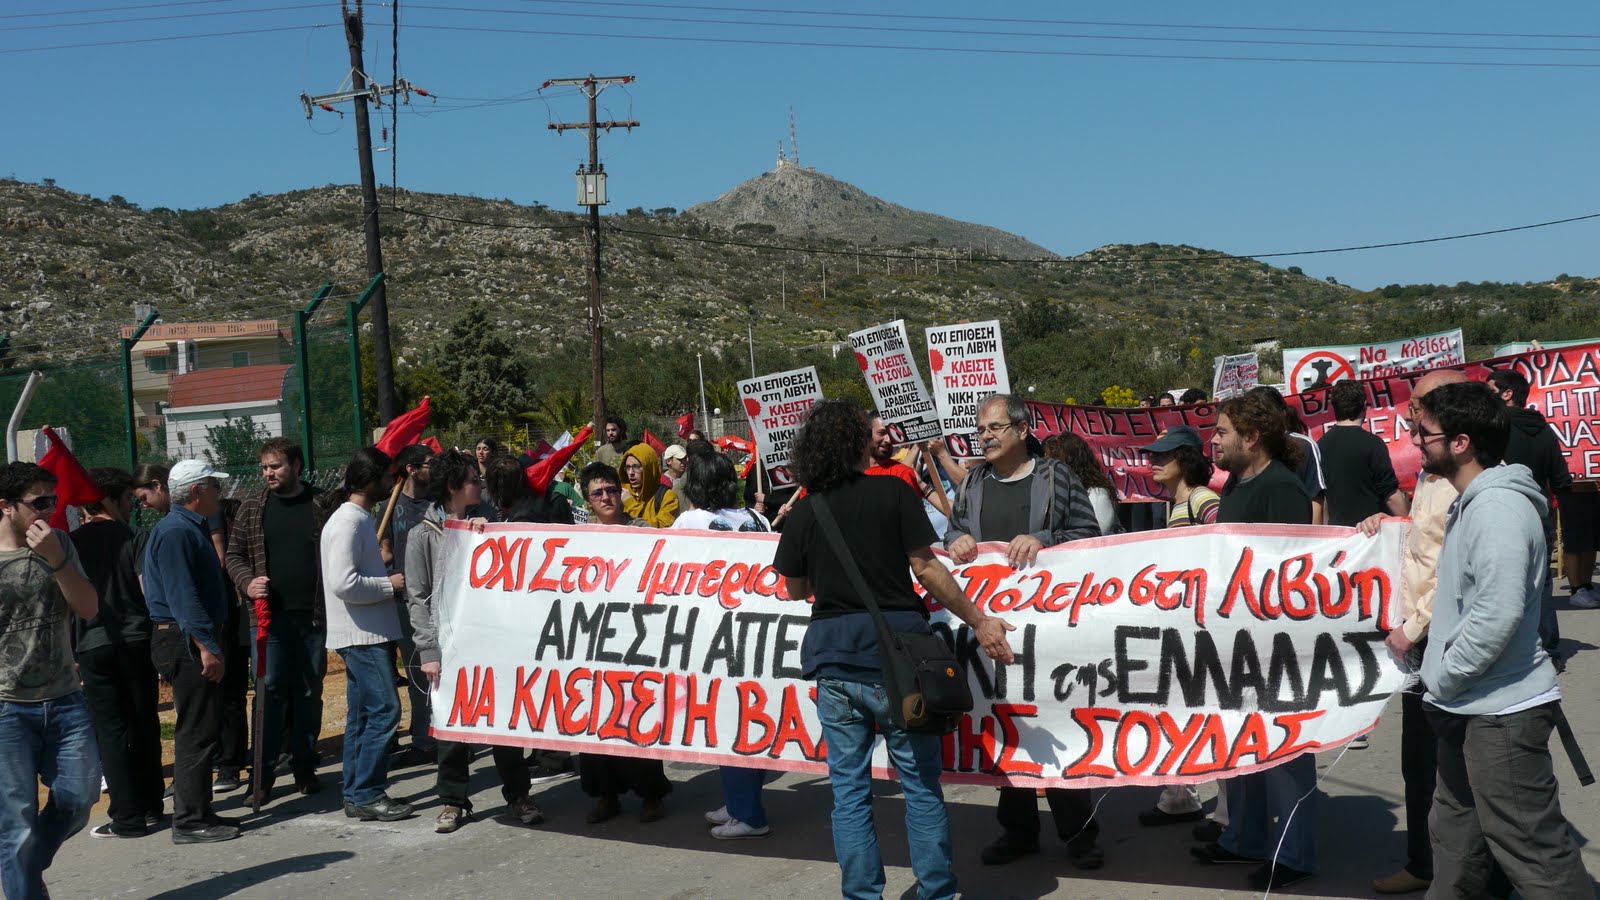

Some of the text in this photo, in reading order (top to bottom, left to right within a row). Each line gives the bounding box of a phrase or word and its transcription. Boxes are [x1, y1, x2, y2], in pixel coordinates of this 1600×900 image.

[852, 326, 901, 348] ΟΧΙ ΕΠΙΘΕΣΗ
[930, 326, 994, 344] ΟΧΙ ΕΠΙΘΕΣΗ
[867, 338, 905, 356] στη ΛΙΒΥΗ
[945, 340, 996, 358] στη ΛΙΒΥΗ
[1360, 346, 1387, 364] Να
[874, 354, 908, 371] ΚΛΕΙΣΤΕ
[951, 358, 995, 374] ΚΛΕΙΣΤΕ
[743, 371, 814, 394] ΟΧΙ ΕΠΙΘΕΣΗ
[871, 366, 913, 384] ΤΗ ΣΟΥΔΑ
[943, 372, 997, 388] ΤΗ ΣΟΥΔΑ
[761, 383, 817, 402] στη ΛΙΒΥΗ
[878, 381, 917, 398] ΝΙΚΗ ΣΤΙΣ
[948, 391, 973, 404] ΝΙΚΗ
[769, 398, 815, 416] ΚΛΕΙΣΤΕ
[885, 392, 920, 408] ΑΡΑΒΙΚΕΣ
[880, 401, 932, 420] ΕΠΑΝΑΣΤΑΣΕΙΣ
[951, 405, 976, 416] ΑΡΑΒ
[762, 418, 779, 429] ΤΗ
[1052, 405, 1160, 437] ΚΛΕΙΣΕΙ
[768, 429, 795, 443] ΝΙΚΗ
[774, 441, 793, 452] ΑΡΑ
[766, 451, 791, 464] ΕΠΑΝ
[470, 536, 533, 592] ΟΧΙ
[961, 563, 1124, 628] Πόλεμο
[1217, 546, 1393, 631] Λιβύη
[534, 598, 700, 671] ΑΜΕΣΗ
[1114, 625, 1393, 713] ΕΛΛΑΔΑΣ
[446, 665, 496, 728] ΝΑ
[508, 665, 676, 748] ΚΛΕΙΣΕΙ
[681, 677, 722, 748] Η
[1063, 706, 1328, 780] ΣΟΥΔΑΣ
